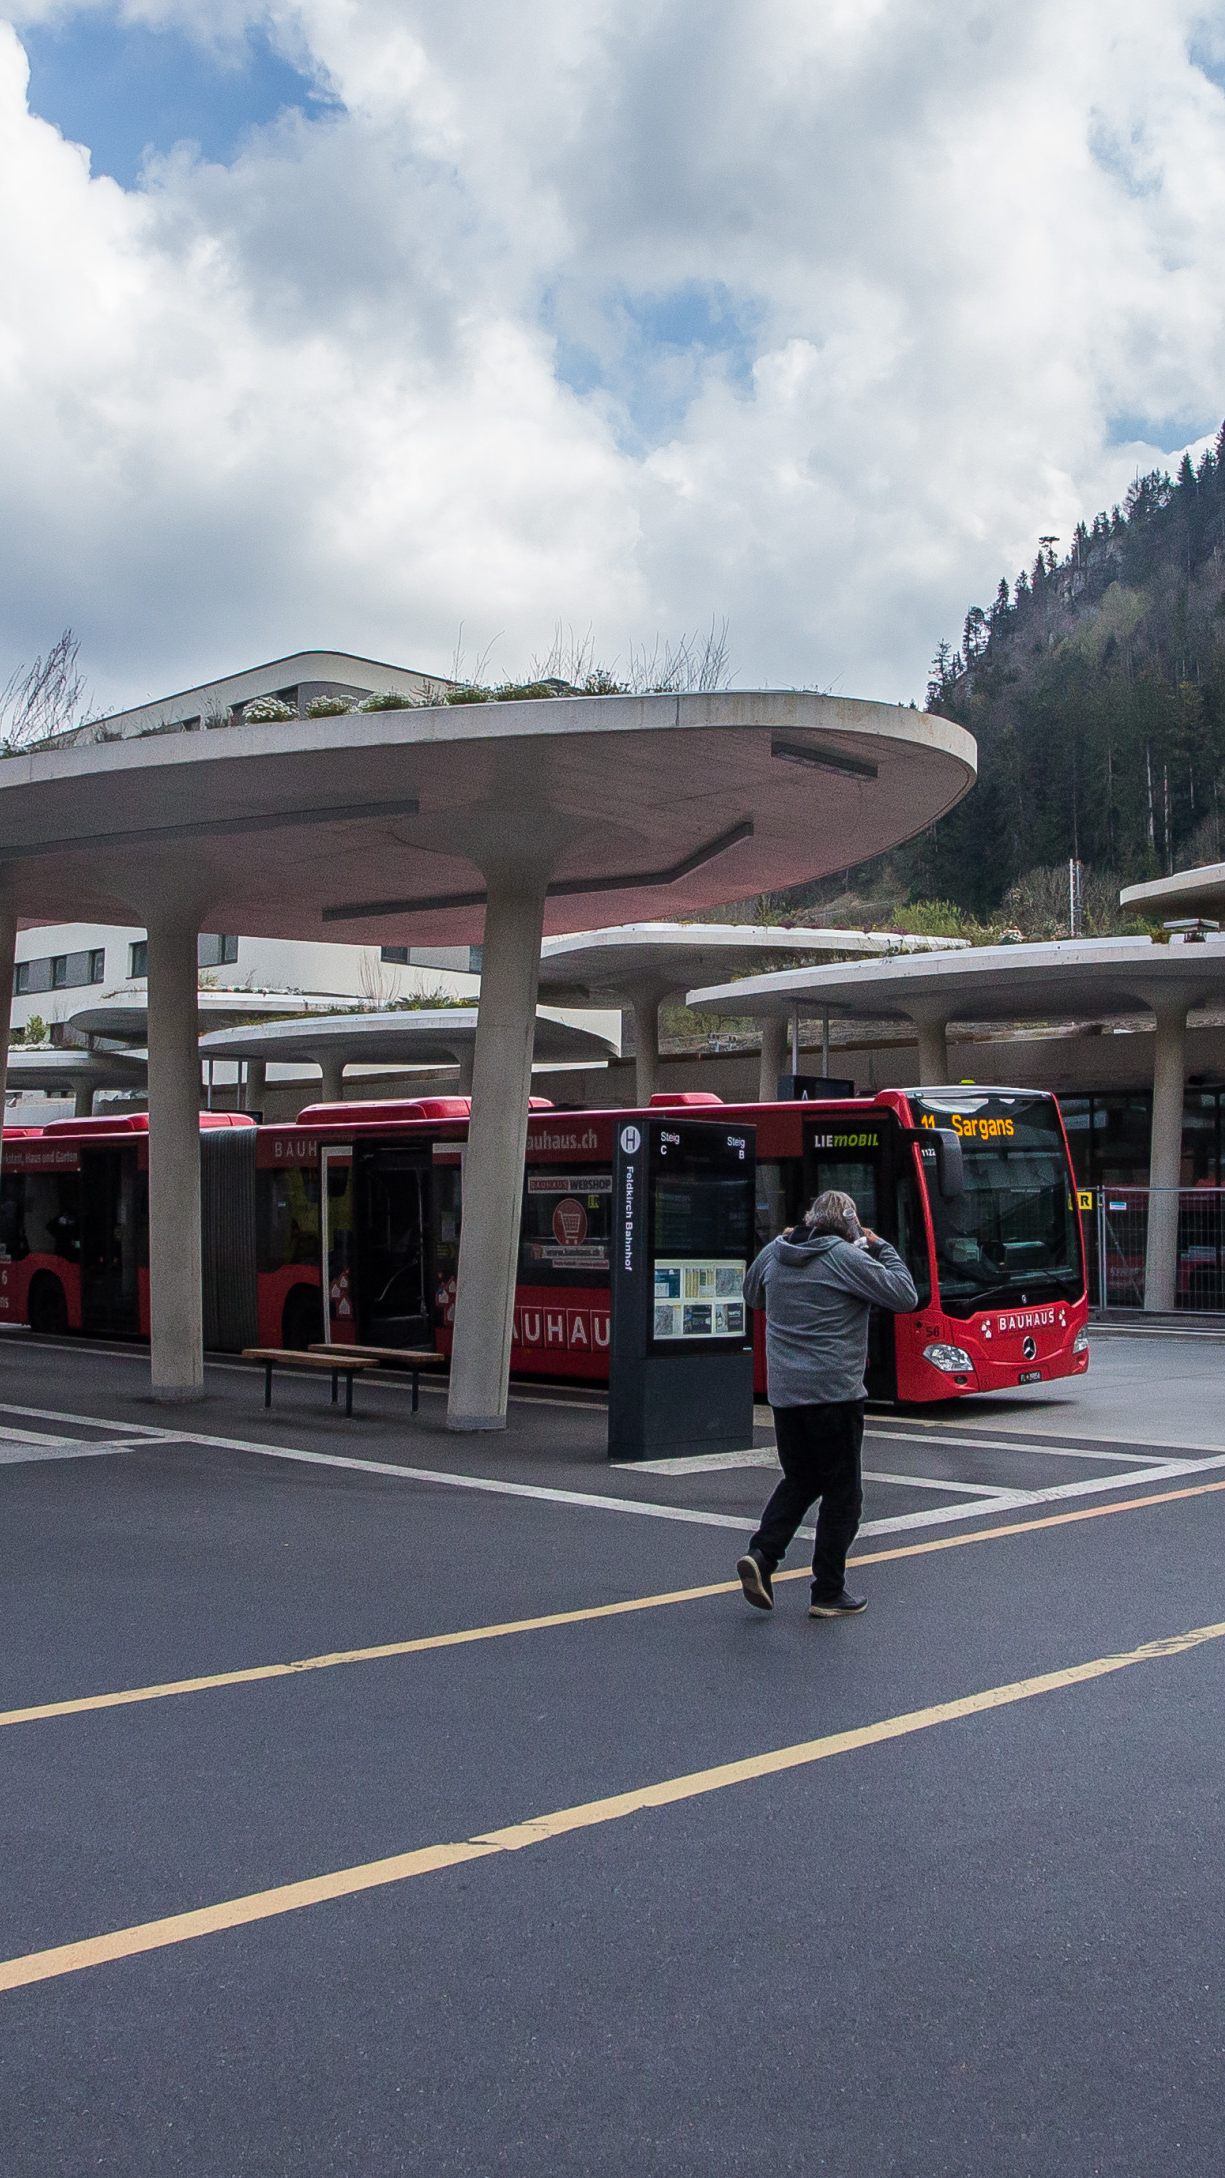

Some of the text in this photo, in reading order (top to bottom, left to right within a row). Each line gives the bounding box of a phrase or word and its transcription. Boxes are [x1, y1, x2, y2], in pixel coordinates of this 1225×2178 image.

[921, 1114, 1015, 1140] 11 Sargans
[527, 1128, 598, 1150] auhaus.ch
[660, 1131, 681, 1145] Steig
[727, 1136, 746, 1149] Steig
[660, 1145, 668, 1155] C
[738, 1149, 746, 1160] B
[1080, 1195, 1089, 1207] R
[624, 1165, 635, 1272] Feldkirch Bahnhof
[999, 1311, 1056, 1331] BAUHAUS
